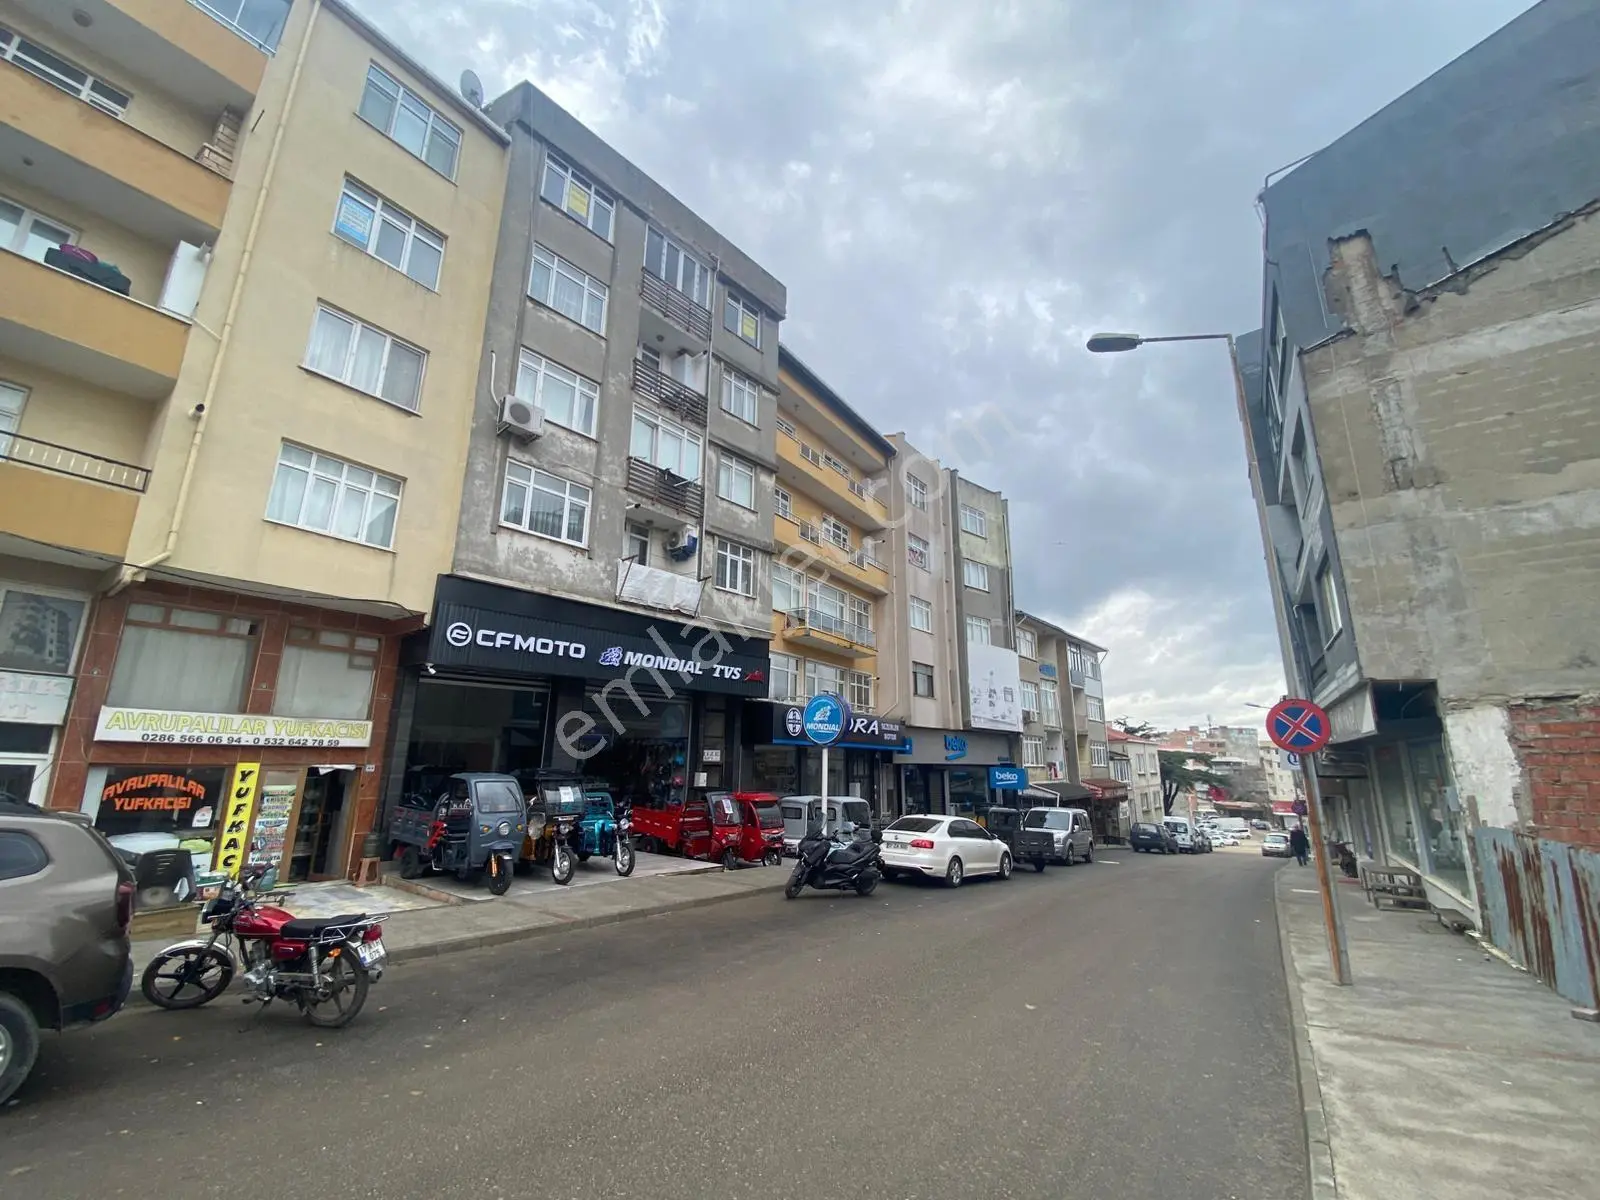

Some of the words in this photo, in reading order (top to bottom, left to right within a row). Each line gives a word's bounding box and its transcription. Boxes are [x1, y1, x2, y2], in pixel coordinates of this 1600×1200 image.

[475, 629, 587, 660] CFMOTO
[623, 651, 704, 675] MONDIAL
[712, 664, 743, 680] TVS
[105, 711, 267, 735] AVRUPALILAR
[272, 720, 369, 739] YUFKACISI
[806, 722, 840, 732] MONDIAL
[141, 733, 175, 743] 0286
[179, 734, 203, 744] 566
[207, 735, 223, 744] 06
[227, 736, 242, 745] 94
[253, 736, 260, 745] 0
[264, 737, 285, 746] 532
[288, 738, 309, 747] 642
[312, 739, 325, 747] 78
[327, 739, 340, 747] 59
[995, 771, 1018, 781] beko
[114, 797, 192, 811] YUFKACISI
